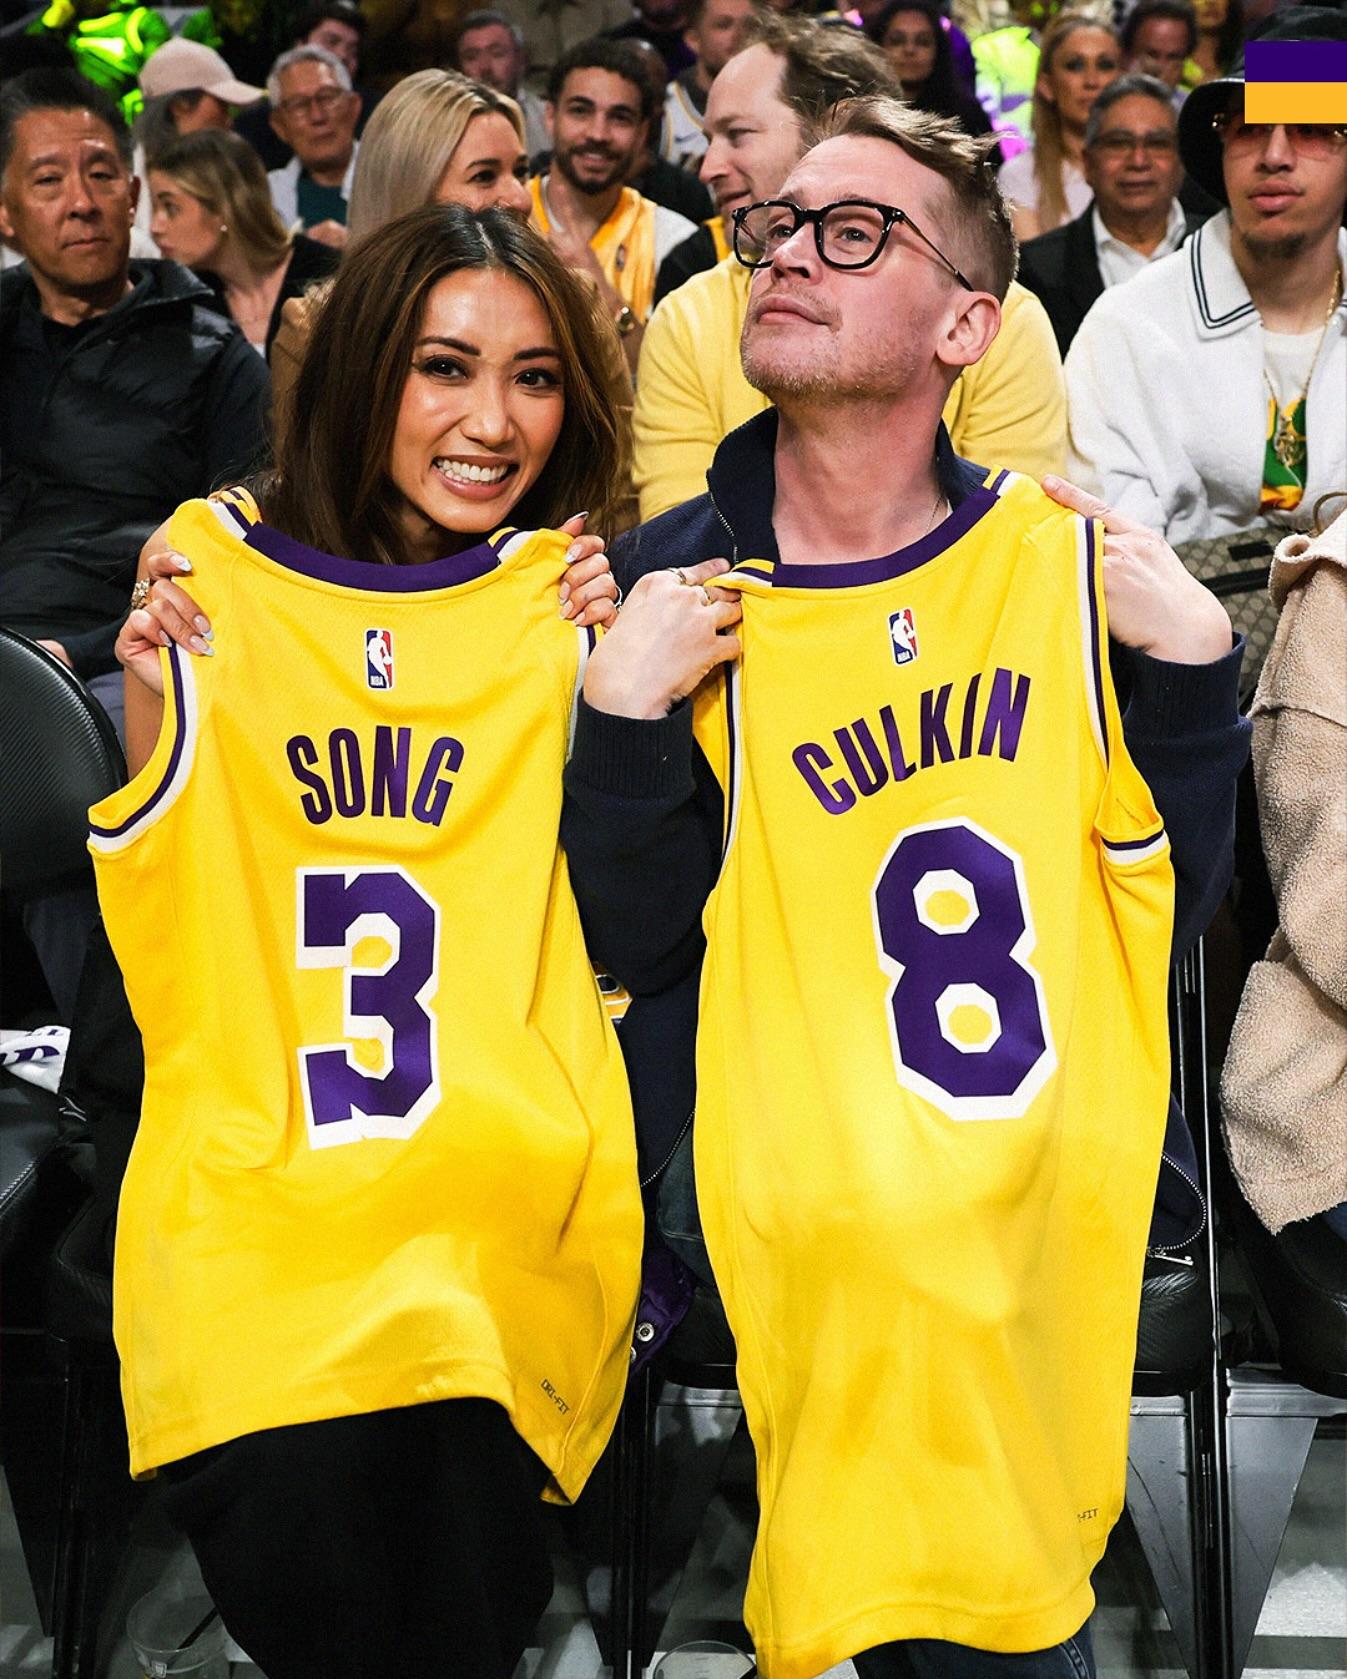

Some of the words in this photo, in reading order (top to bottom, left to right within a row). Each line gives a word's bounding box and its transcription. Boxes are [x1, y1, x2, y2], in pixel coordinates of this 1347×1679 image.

[286, 725, 464, 827] SONG
[792, 667, 1031, 815] CULKIN
[296, 864, 442, 1150] 3
[870, 815, 1059, 1121] 8
[541, 1379, 569, 1415] DRI-FIT
